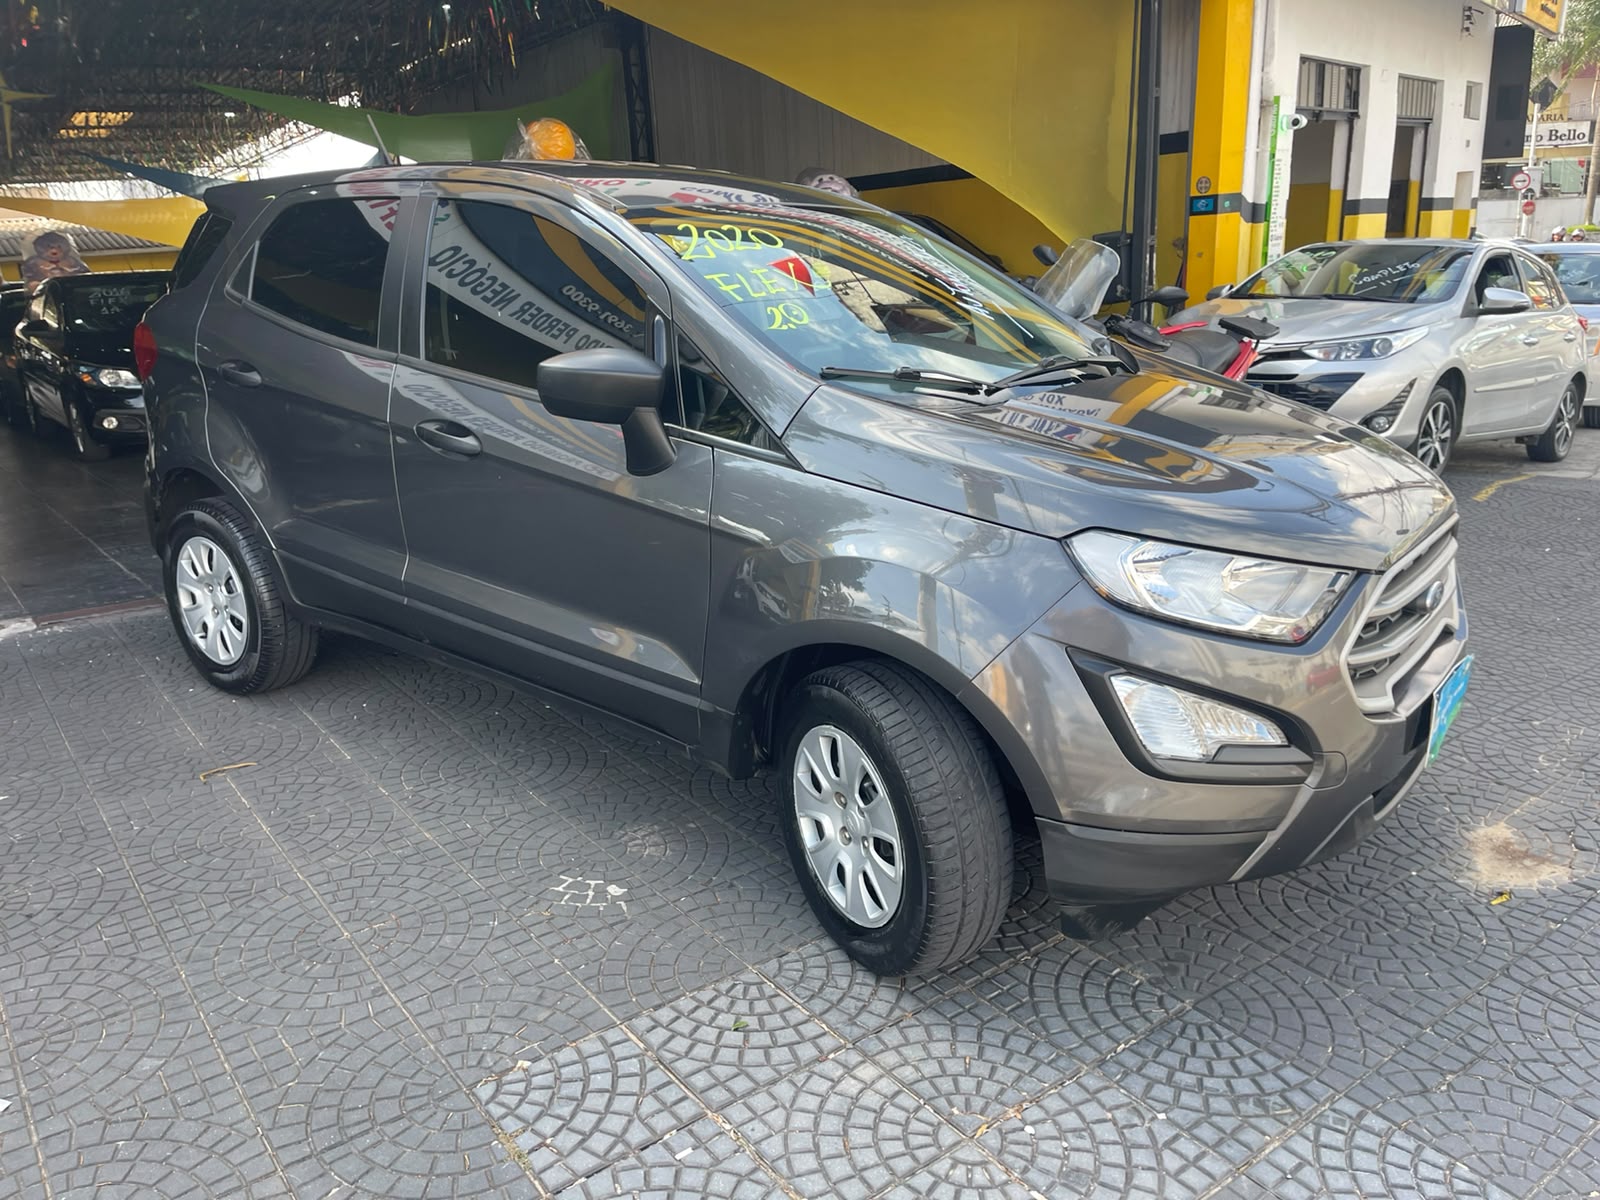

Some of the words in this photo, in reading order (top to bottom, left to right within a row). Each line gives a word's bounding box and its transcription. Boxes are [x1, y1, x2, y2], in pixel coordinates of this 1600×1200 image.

[1548, 129, 1586, 141] Bello
[676, 223, 784, 261] 2020
[704, 261, 832, 302] FLEX
